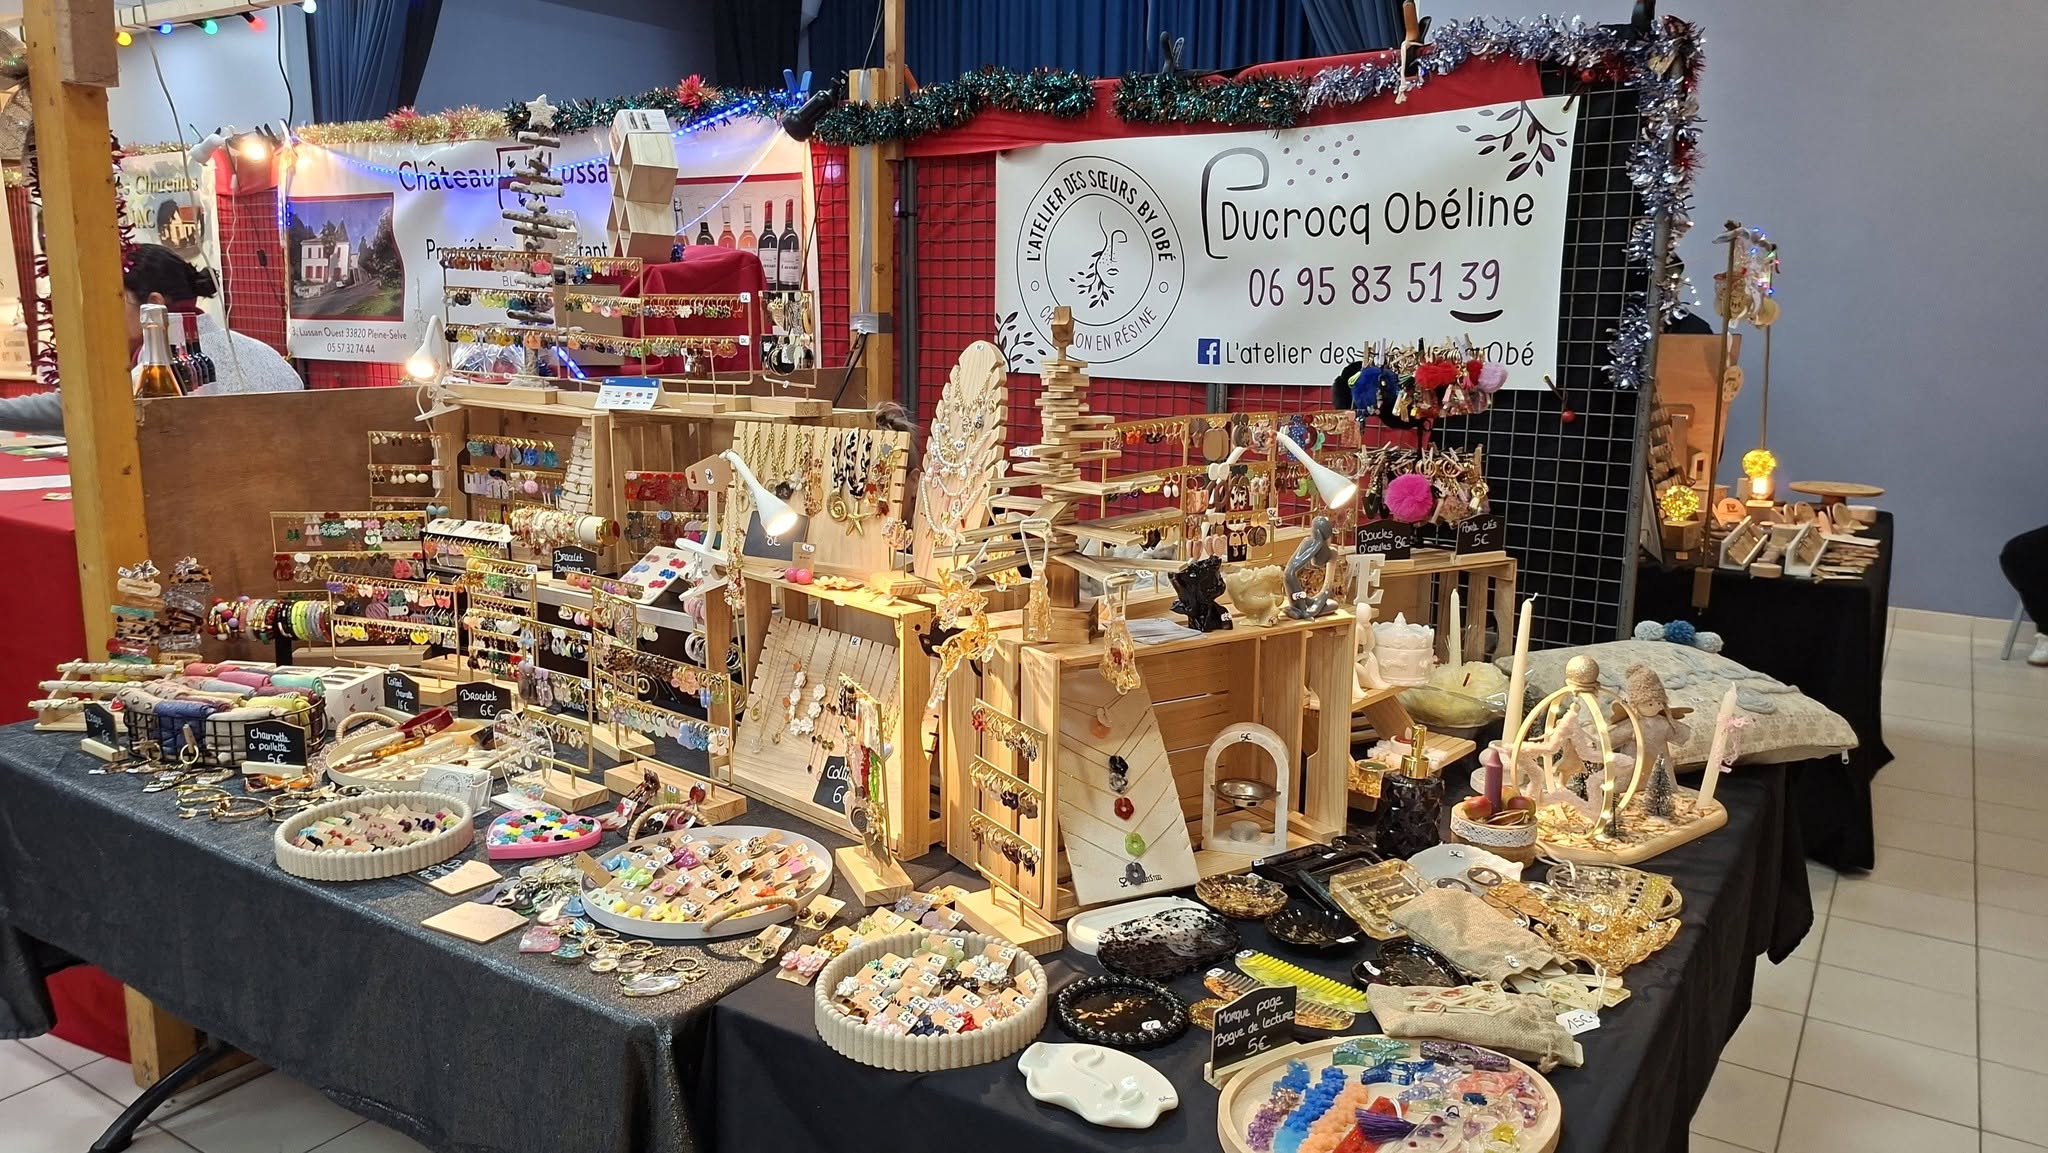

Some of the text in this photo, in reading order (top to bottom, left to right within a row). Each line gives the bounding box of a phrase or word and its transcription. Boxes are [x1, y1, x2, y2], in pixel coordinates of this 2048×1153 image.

[399, 160, 495, 192] Château
[1026, 168, 1177, 263] L'ATELIER DES SŒURS BY OBÉ
[1221, 186, 1536, 246] Ducrocq Obéline
[1249, 258, 1501, 308] 06 95 83 51 39
[299, 326, 323, 337] Lussan
[323, 326, 344, 338] Ouest
[345, 327, 366, 339] 33820
[367, 328, 407, 340] Pleine-Selve
[1096, 334, 1112, 351] EN
[1115, 305, 1157, 347] RÉSINE
[326, 342, 376, 354] 05 57 32 74 44
[1226, 341, 1313, 365] L'atelier
[1320, 341, 1355, 365] des
[1488, 340, 1535, 366] Obé
[1460, 519, 1497, 533] Porte clés
[1358, 528, 1393, 543] Boucles
[1395, 535, 1411, 550] 8€
[1471, 533, 1489, 547] 5€
[460, 688, 498, 702] Bracelet
[480, 704, 496, 717] 6€
[267, 753, 287, 764] 5€
[832, 785, 845, 804] 6
[912, 997, 927, 1009] 5€
[1218, 995, 1284, 1027] Marque page
[901, 1012, 915, 1024] 5€
[1214, 1028, 1245, 1048] Bague
[1247, 1021, 1260, 1034] de
[1245, 1035, 1271, 1057] 5€
